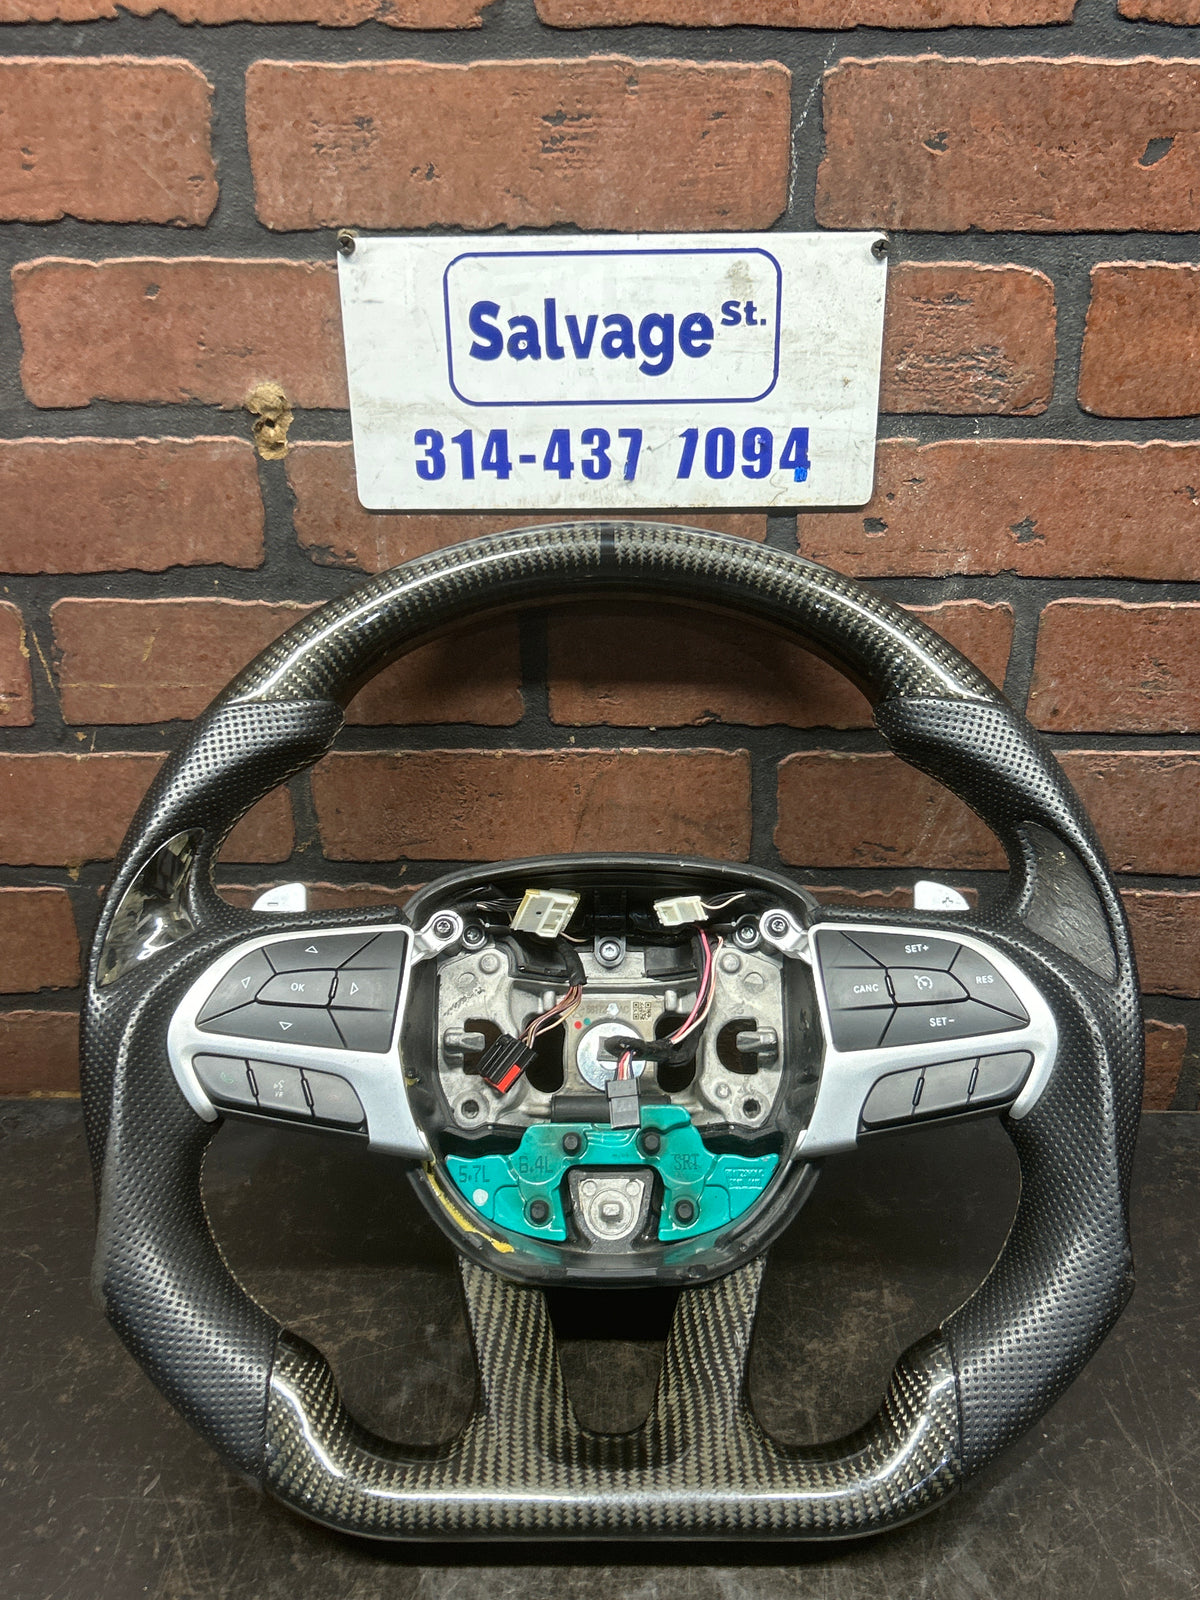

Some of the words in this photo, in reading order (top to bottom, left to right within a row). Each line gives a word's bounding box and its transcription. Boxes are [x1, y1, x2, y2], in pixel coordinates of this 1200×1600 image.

[468, 297, 715, 376] Salvage
[721, 300, 767, 327] St.
[414, 428, 643, 481] 314-437
[904, 943, 930, 954] SET+
[975, 975, 995, 985] RES
[290, 982, 306, 993] OK
[853, 983, 879, 994] CANC
[672, 1153, 700, 1171] SRT
[458, 1164, 491, 1183] 5.7L
